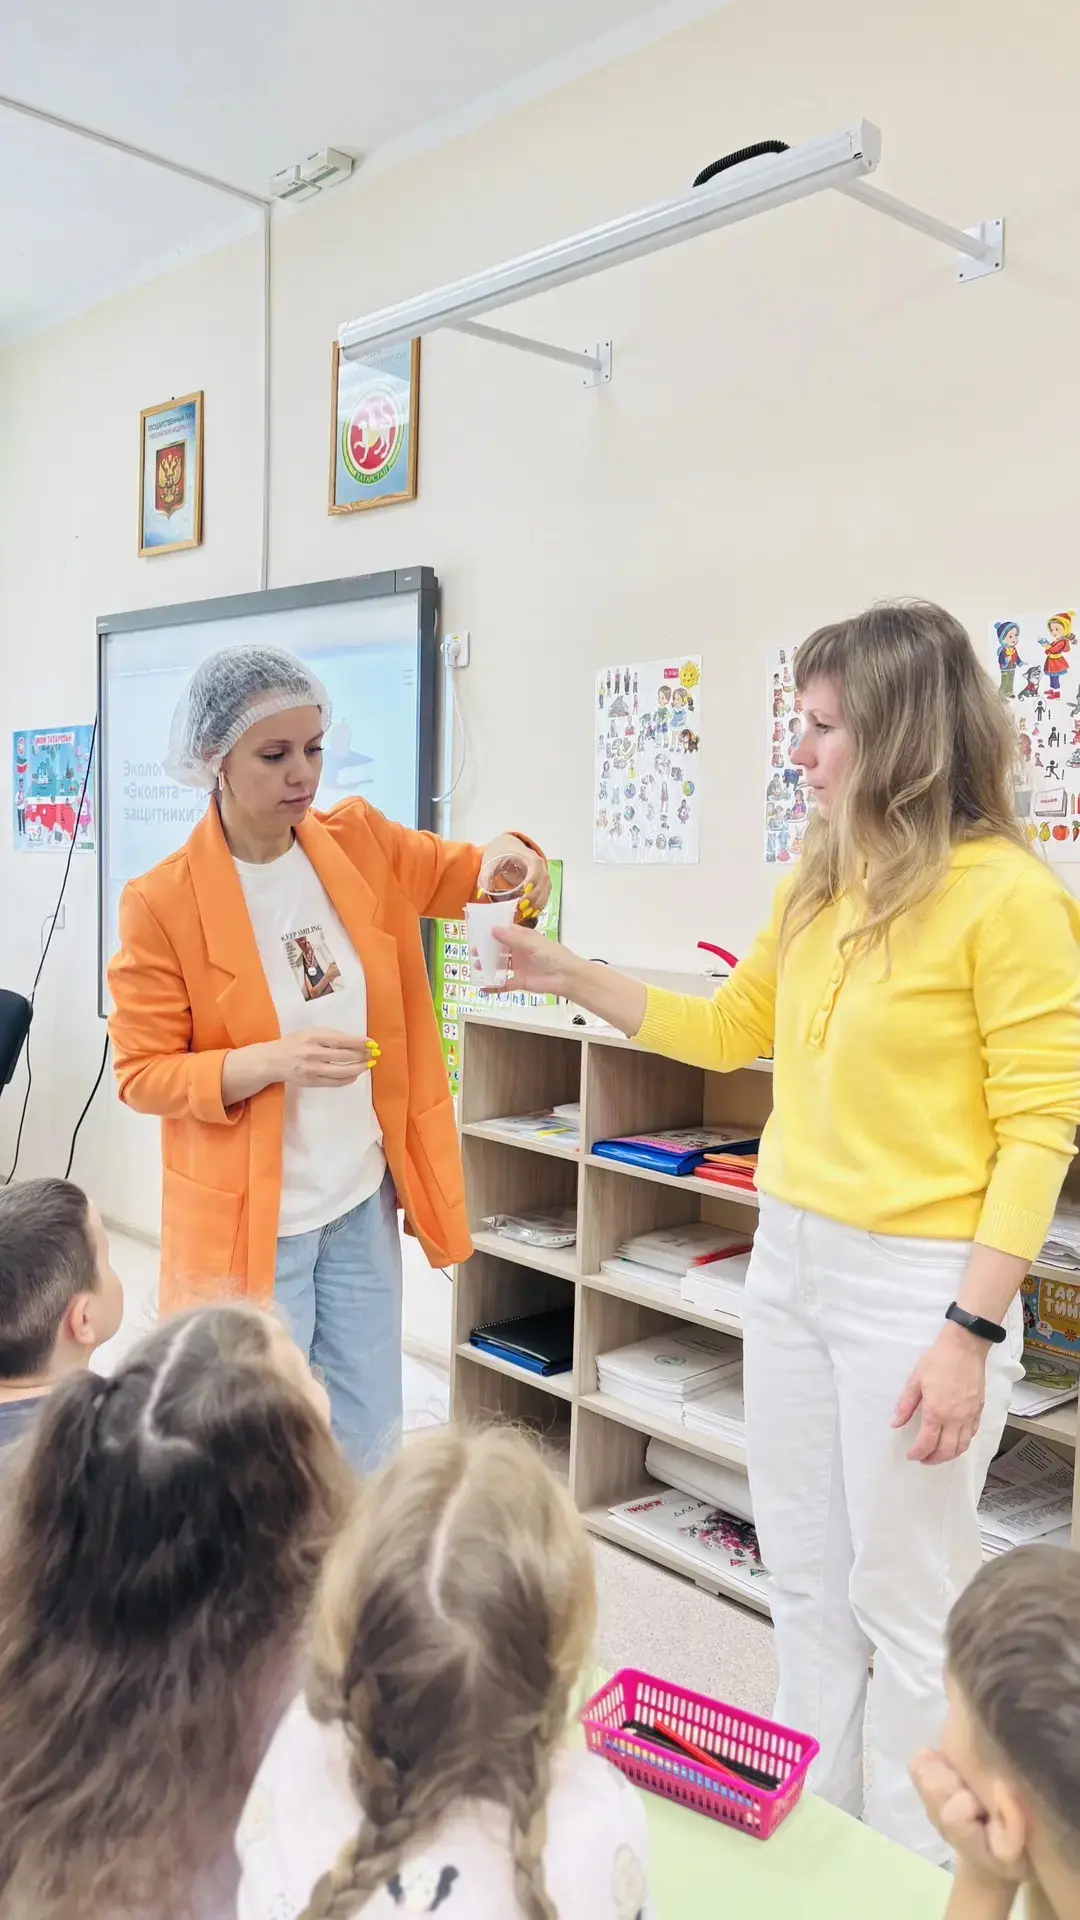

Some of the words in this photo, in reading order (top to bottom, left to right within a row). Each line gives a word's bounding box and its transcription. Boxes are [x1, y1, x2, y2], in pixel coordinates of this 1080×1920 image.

[123, 807, 194, 824] защитники
[445, 944, 451, 955] И
[1044, 1297, 1080, 1319] ТИН
